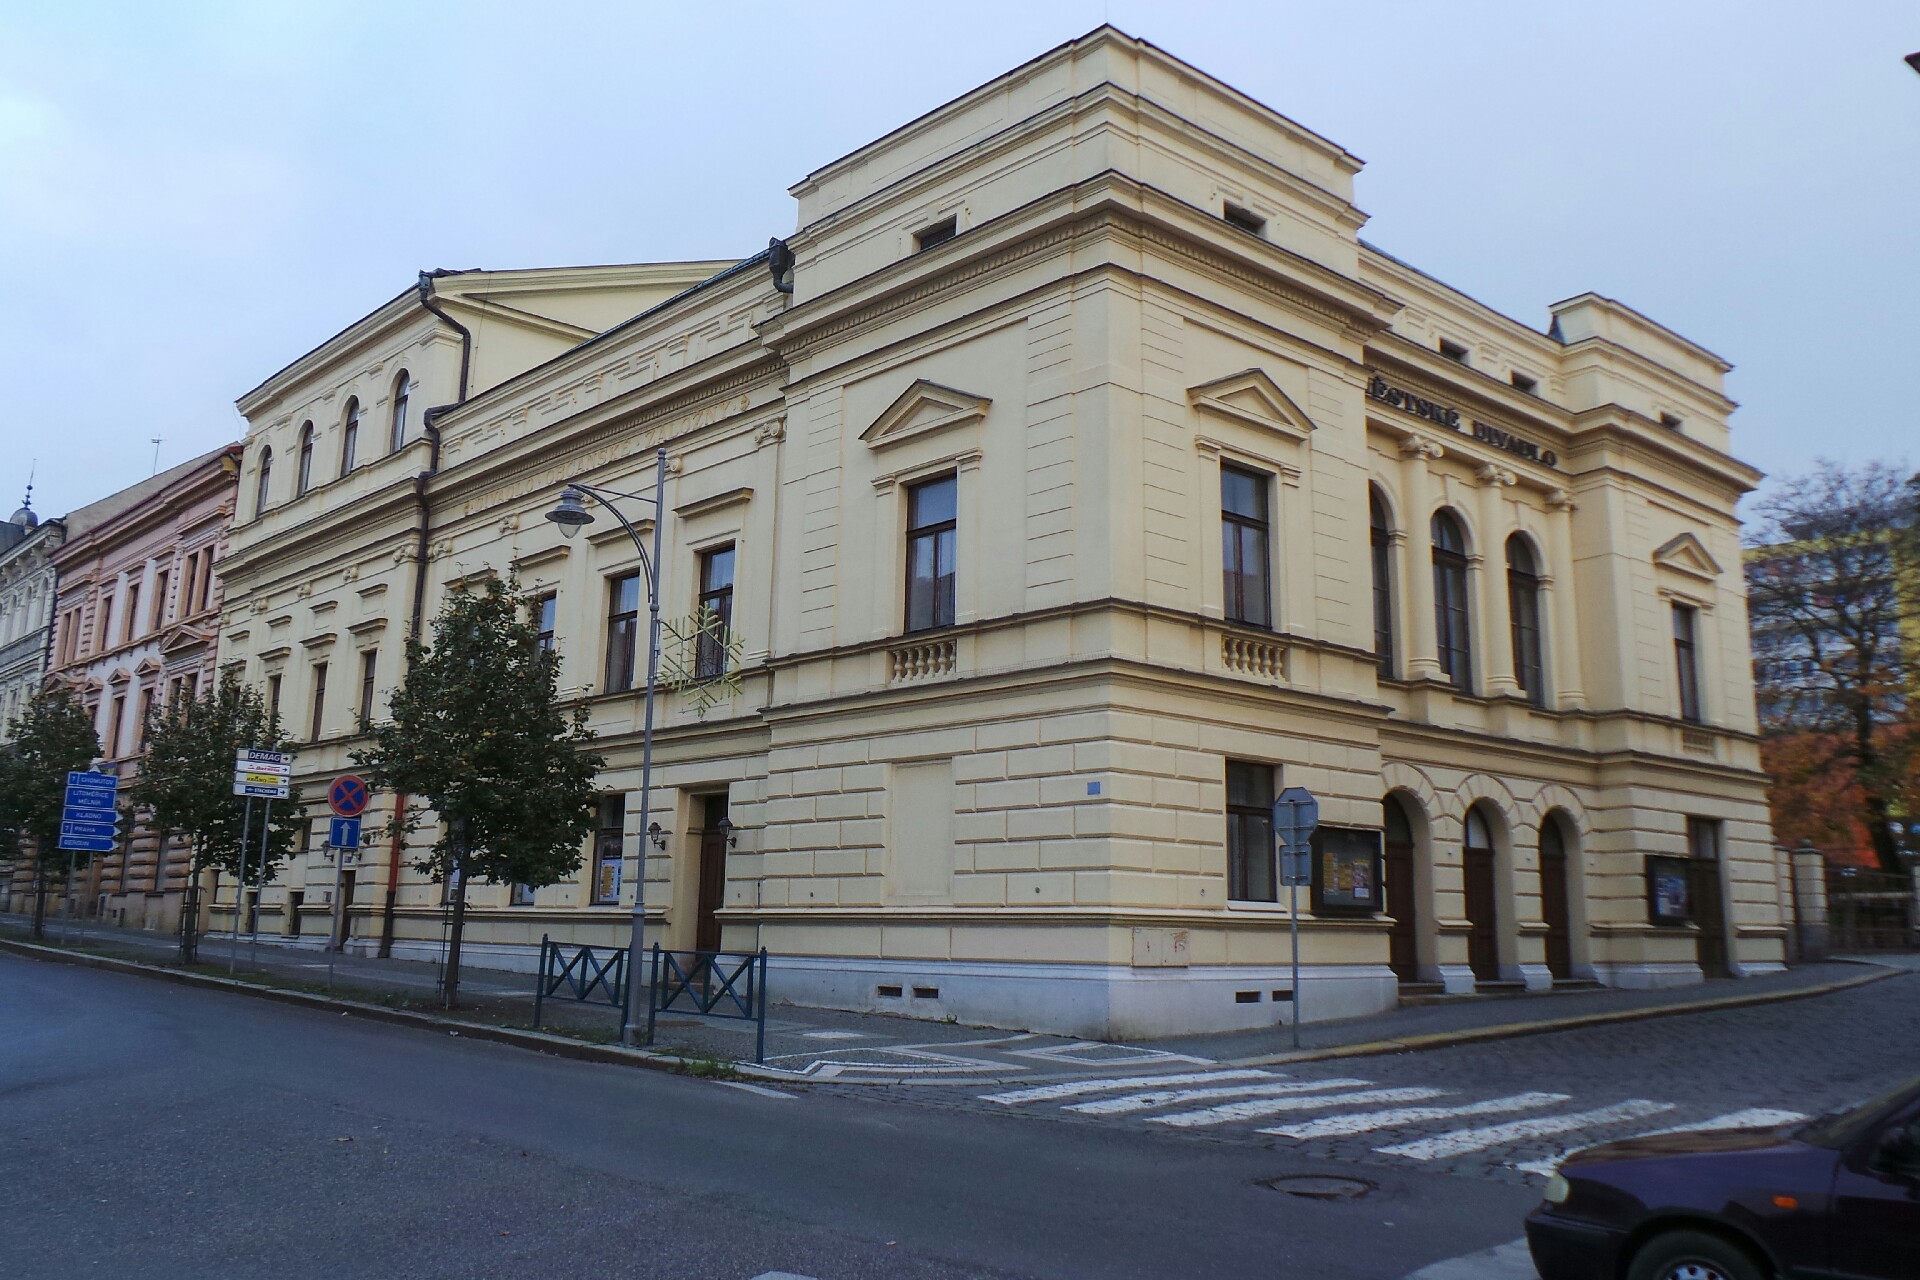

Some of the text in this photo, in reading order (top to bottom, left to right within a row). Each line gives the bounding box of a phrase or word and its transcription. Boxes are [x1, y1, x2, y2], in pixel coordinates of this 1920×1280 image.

[1473, 420, 1557, 466] DIVADLO
[249, 752, 280, 761] DEMAG
[81, 777, 114, 785] CHOMUTOV
